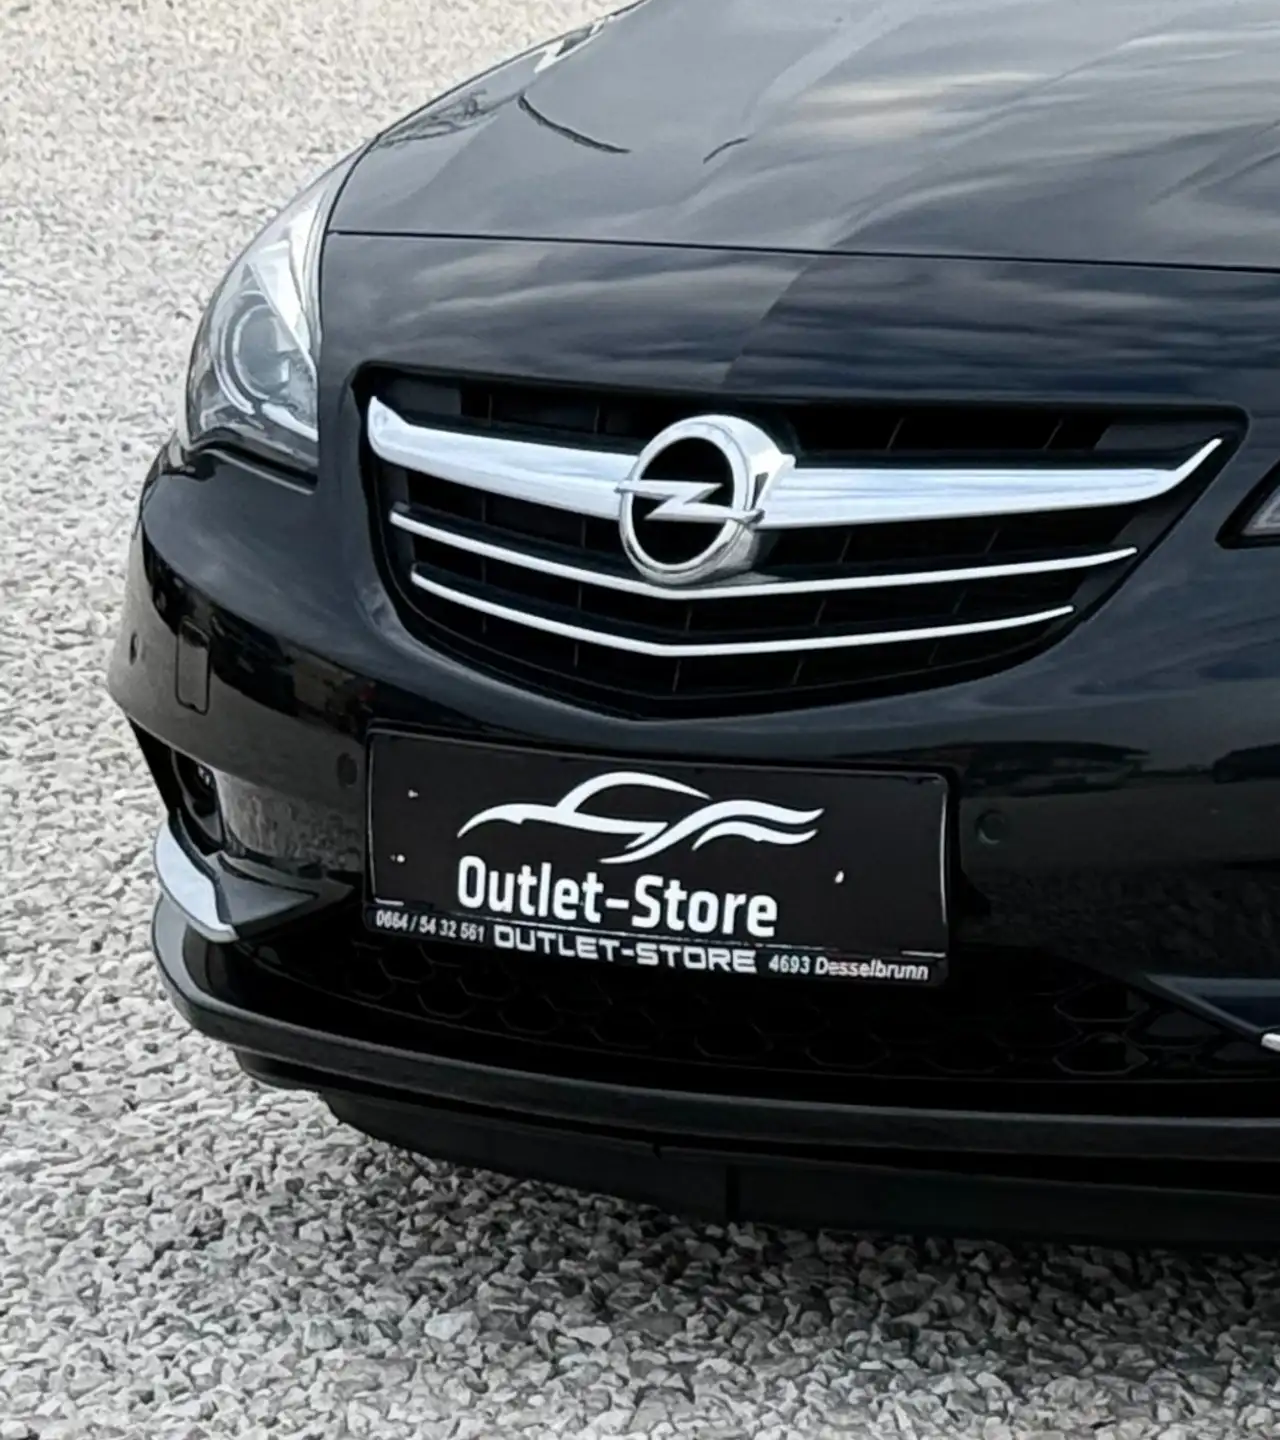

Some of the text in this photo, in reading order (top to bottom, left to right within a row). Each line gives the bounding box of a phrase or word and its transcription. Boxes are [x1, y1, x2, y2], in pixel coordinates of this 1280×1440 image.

[457, 855, 778, 938] Outlet-Store
[419, 915, 437, 934] 54
[439, 919, 457, 938] 32
[493, 924, 757, 973] OUTLET-STORE
[768, 954, 811, 974] 4693
[815, 956, 929, 981] Desselbrunn
